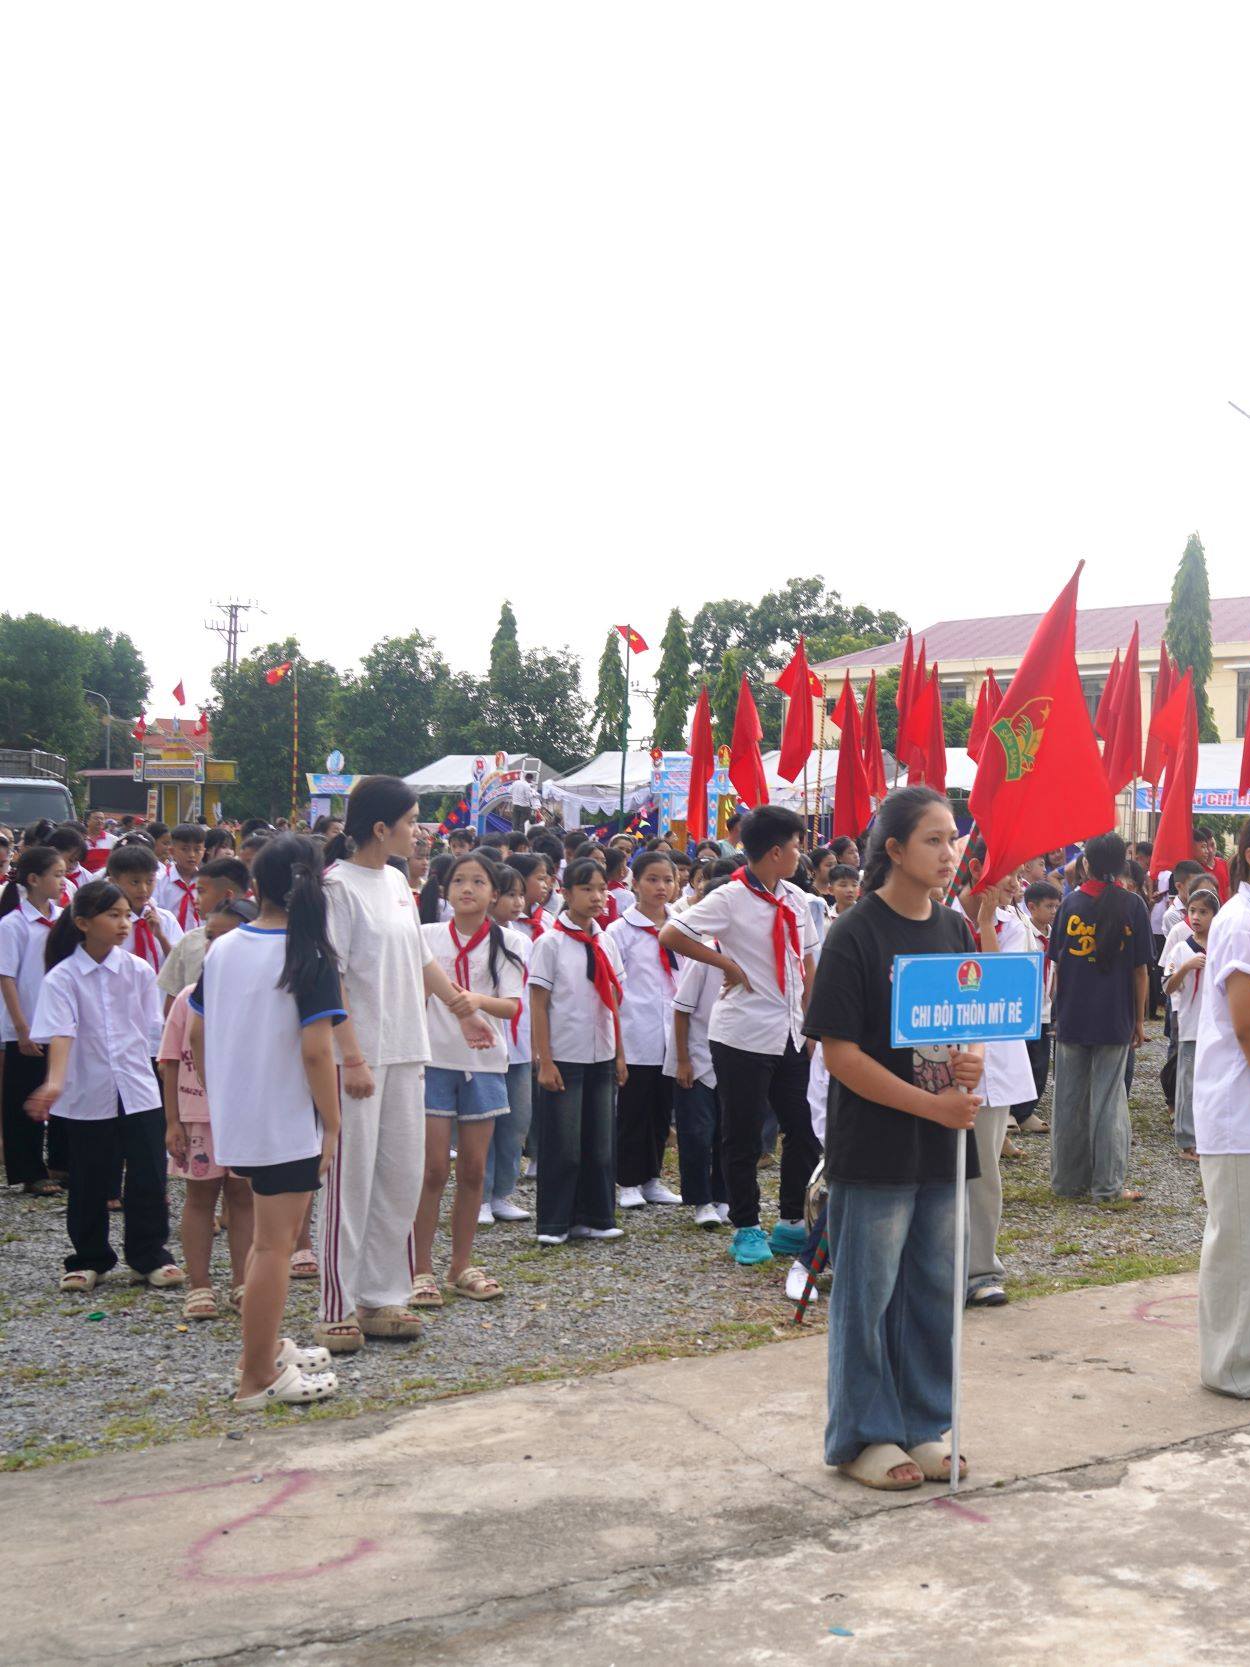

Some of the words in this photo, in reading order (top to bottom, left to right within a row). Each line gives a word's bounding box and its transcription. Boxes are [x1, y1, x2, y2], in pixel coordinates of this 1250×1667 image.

[911, 1004, 931, 1028] CHI
[933, 999, 954, 1032] ĐỘI
[957, 998, 986, 1026] THÔN
[988, 998, 1006, 1025] MỸ
